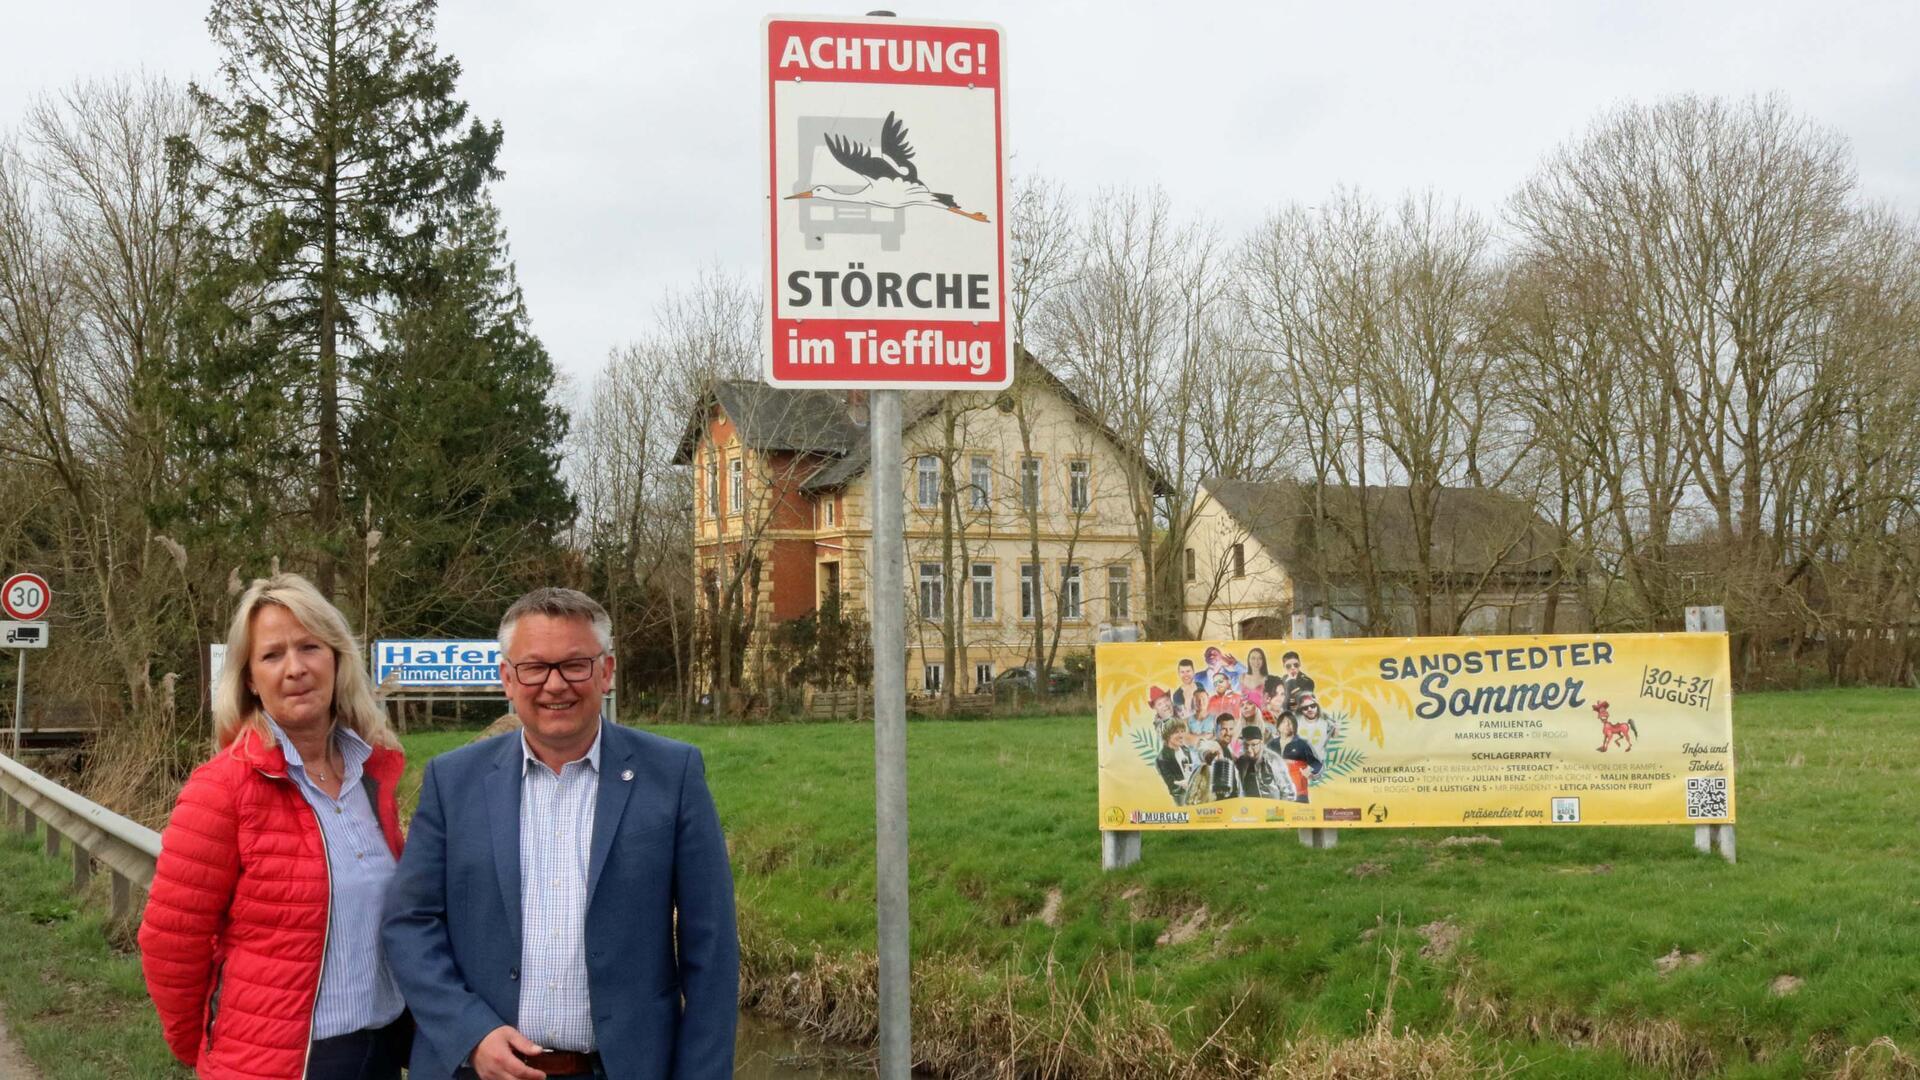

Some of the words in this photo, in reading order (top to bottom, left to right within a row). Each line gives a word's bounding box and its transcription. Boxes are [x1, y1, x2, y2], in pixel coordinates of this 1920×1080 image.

[779, 36, 987, 75] ACHTUNG!
[787, 262, 991, 309] STÖRCHE
[788, 328, 835, 364] im
[845, 330, 991, 374] Tiefflug
[12, 587, 39, 607] 30
[1379, 641, 1613, 680] SANDSTEDTER
[390, 665, 497, 681] Himmelfahrt
[1415, 672, 1586, 719] Sommer
[1643, 685, 1707, 708] AUGUST
[1479, 720, 1543, 729] FAMILIENTAG
[1455, 732, 1491, 740] MARKUS
[1472, 751, 1552, 760] SCHLAGERPARTY
[1682, 742, 1707, 758] Infos
[1710, 742, 1729, 754] und
[1362, 766, 1391, 774] MICKIE
[1506, 764, 1553, 772] STEREOACT
[1688, 760, 1724, 772] Tickets
[1350, 776, 1367, 784] IKKE
[1504, 774, 1526, 782] BENZ
[1600, 773, 1629, 781] MALIN
[1440, 784, 1480, 792] LUSTIGEN
[1560, 783, 1588, 791] LETICA
[1590, 783, 1627, 791] PASSION
[1629, 782, 1653, 790] FRUIT
[1463, 807, 1524, 822] präsentiert
[1525, 810, 1544, 818] von
